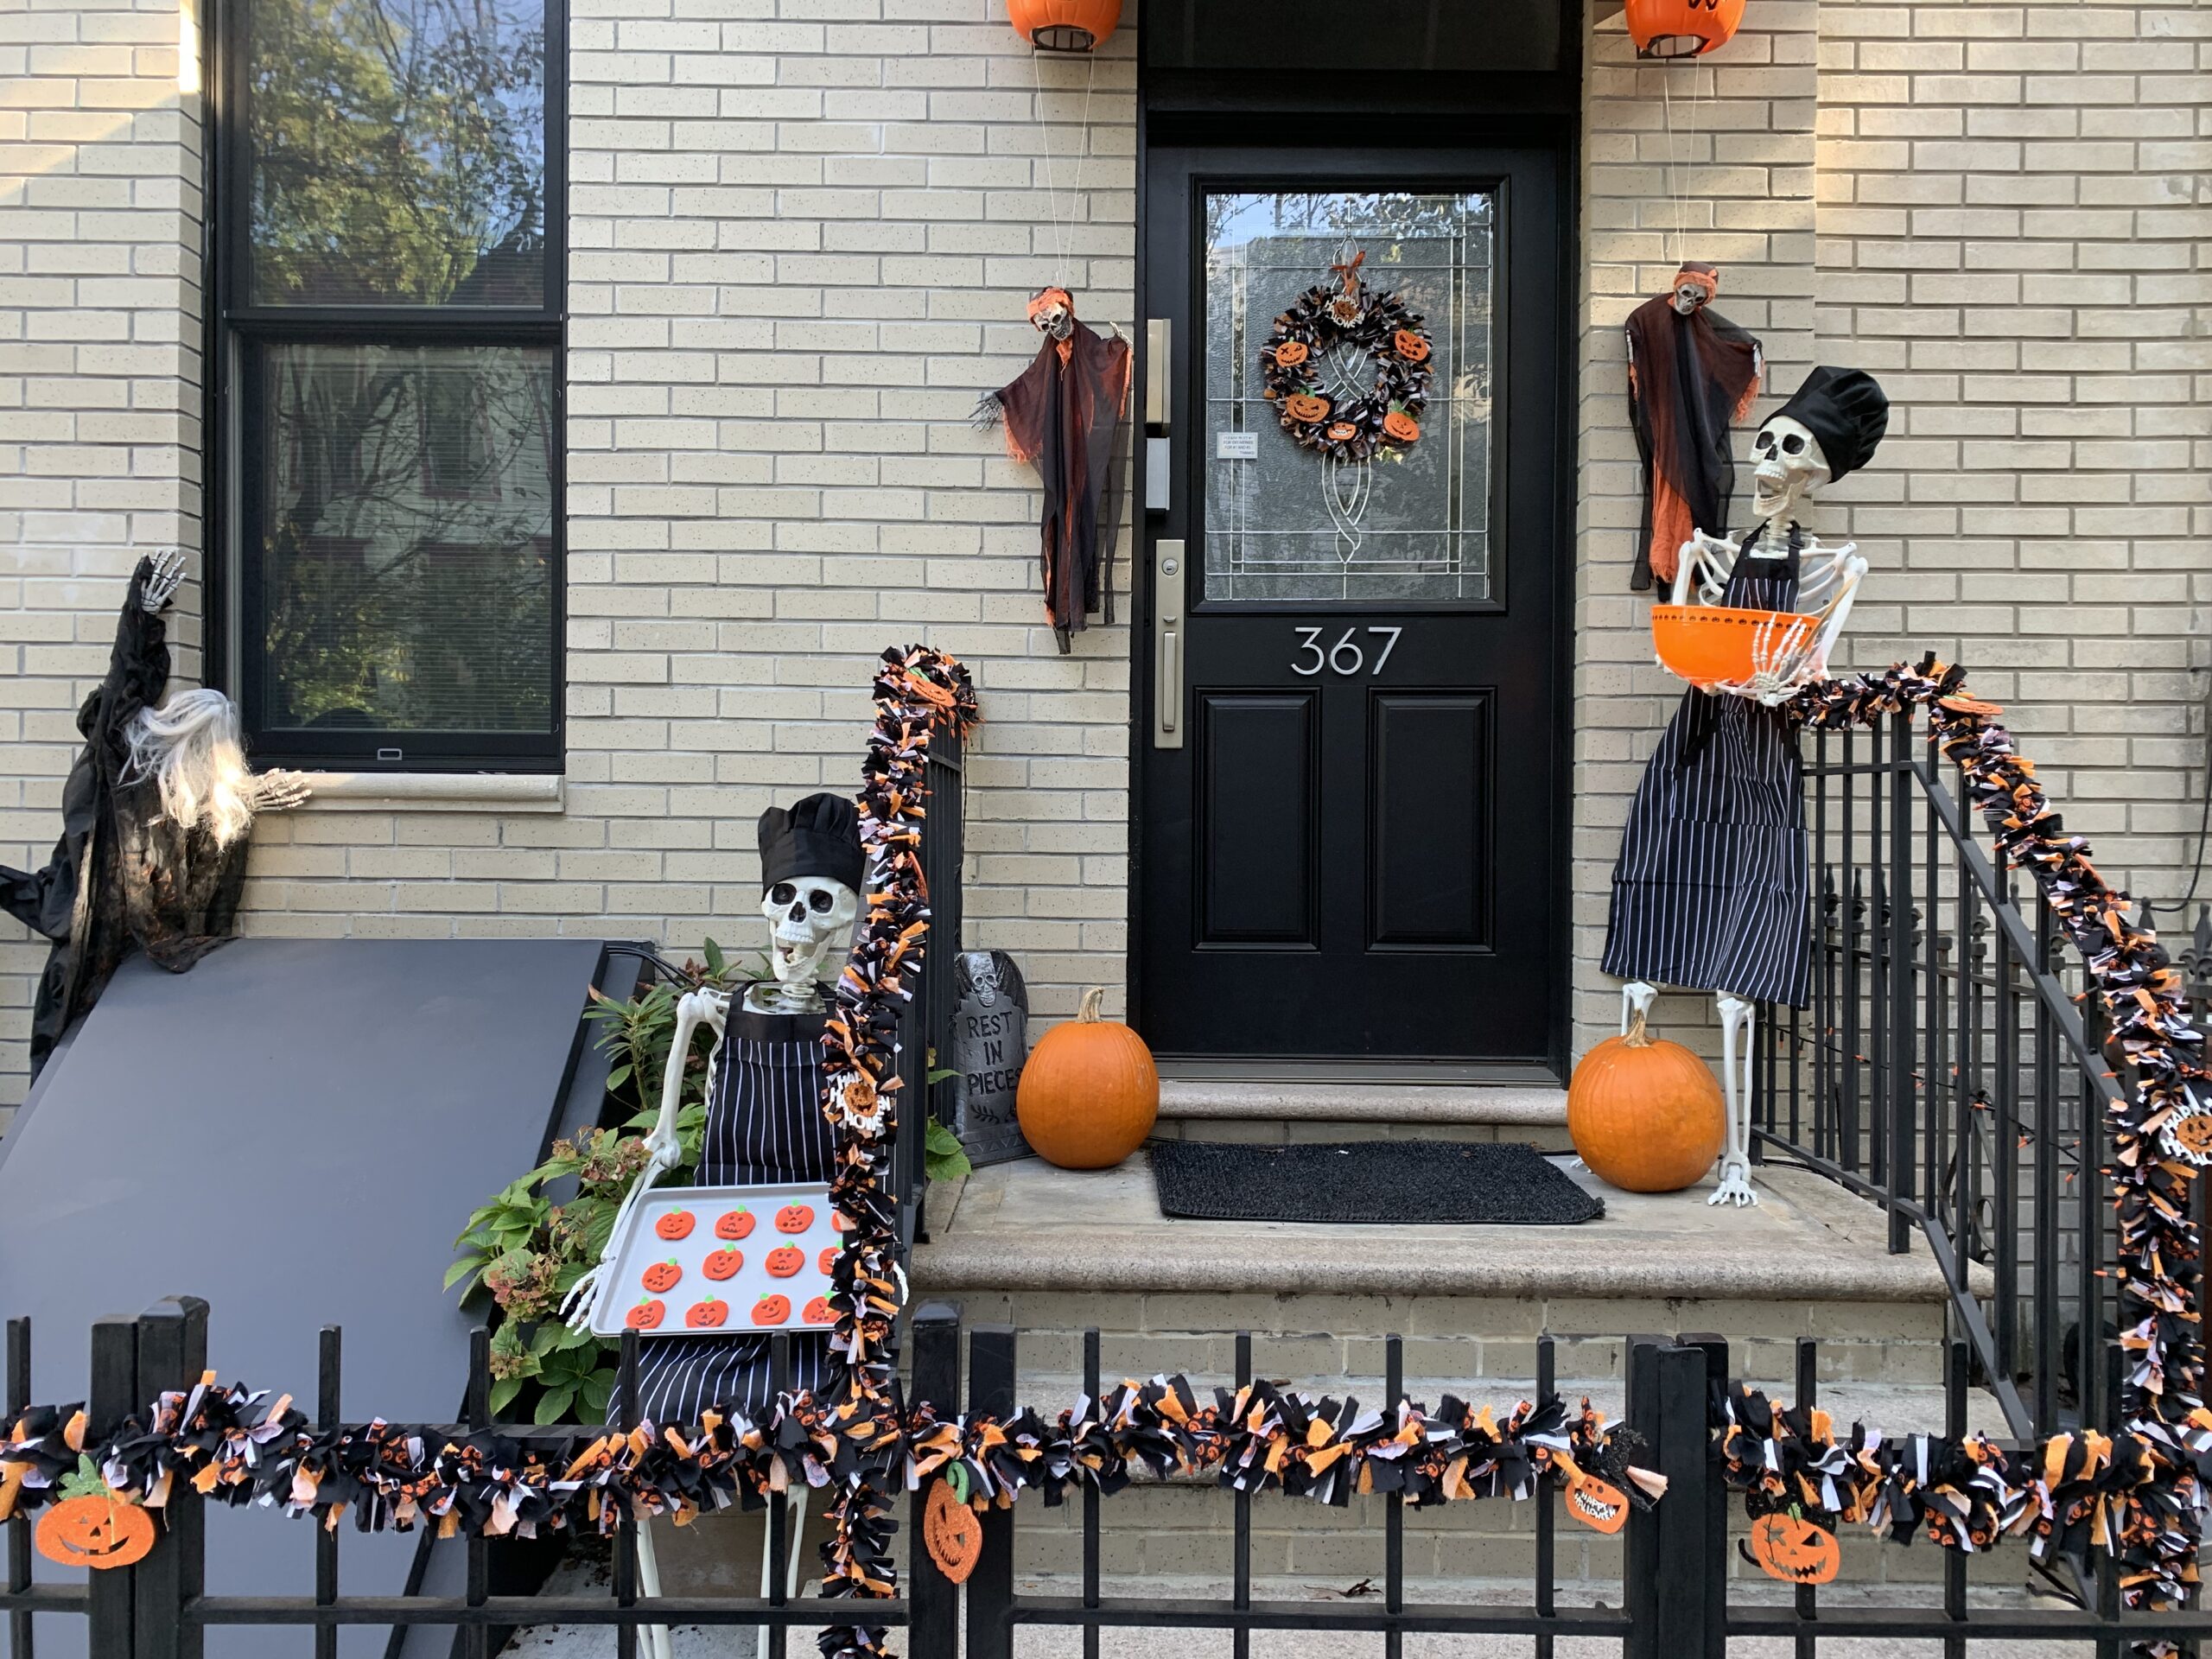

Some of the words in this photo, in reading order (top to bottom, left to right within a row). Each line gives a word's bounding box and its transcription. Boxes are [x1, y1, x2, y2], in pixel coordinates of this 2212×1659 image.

[1332, 295, 1359, 309] HAPPY
[1291, 626, 1402, 675] 367
[967, 1012, 1013, 1037] REST
[983, 1040, 1004, 1065] IN
[830, 1087, 891, 1131] HALLOWEEN
[1581, 1492, 1607, 1512] HAPPY
